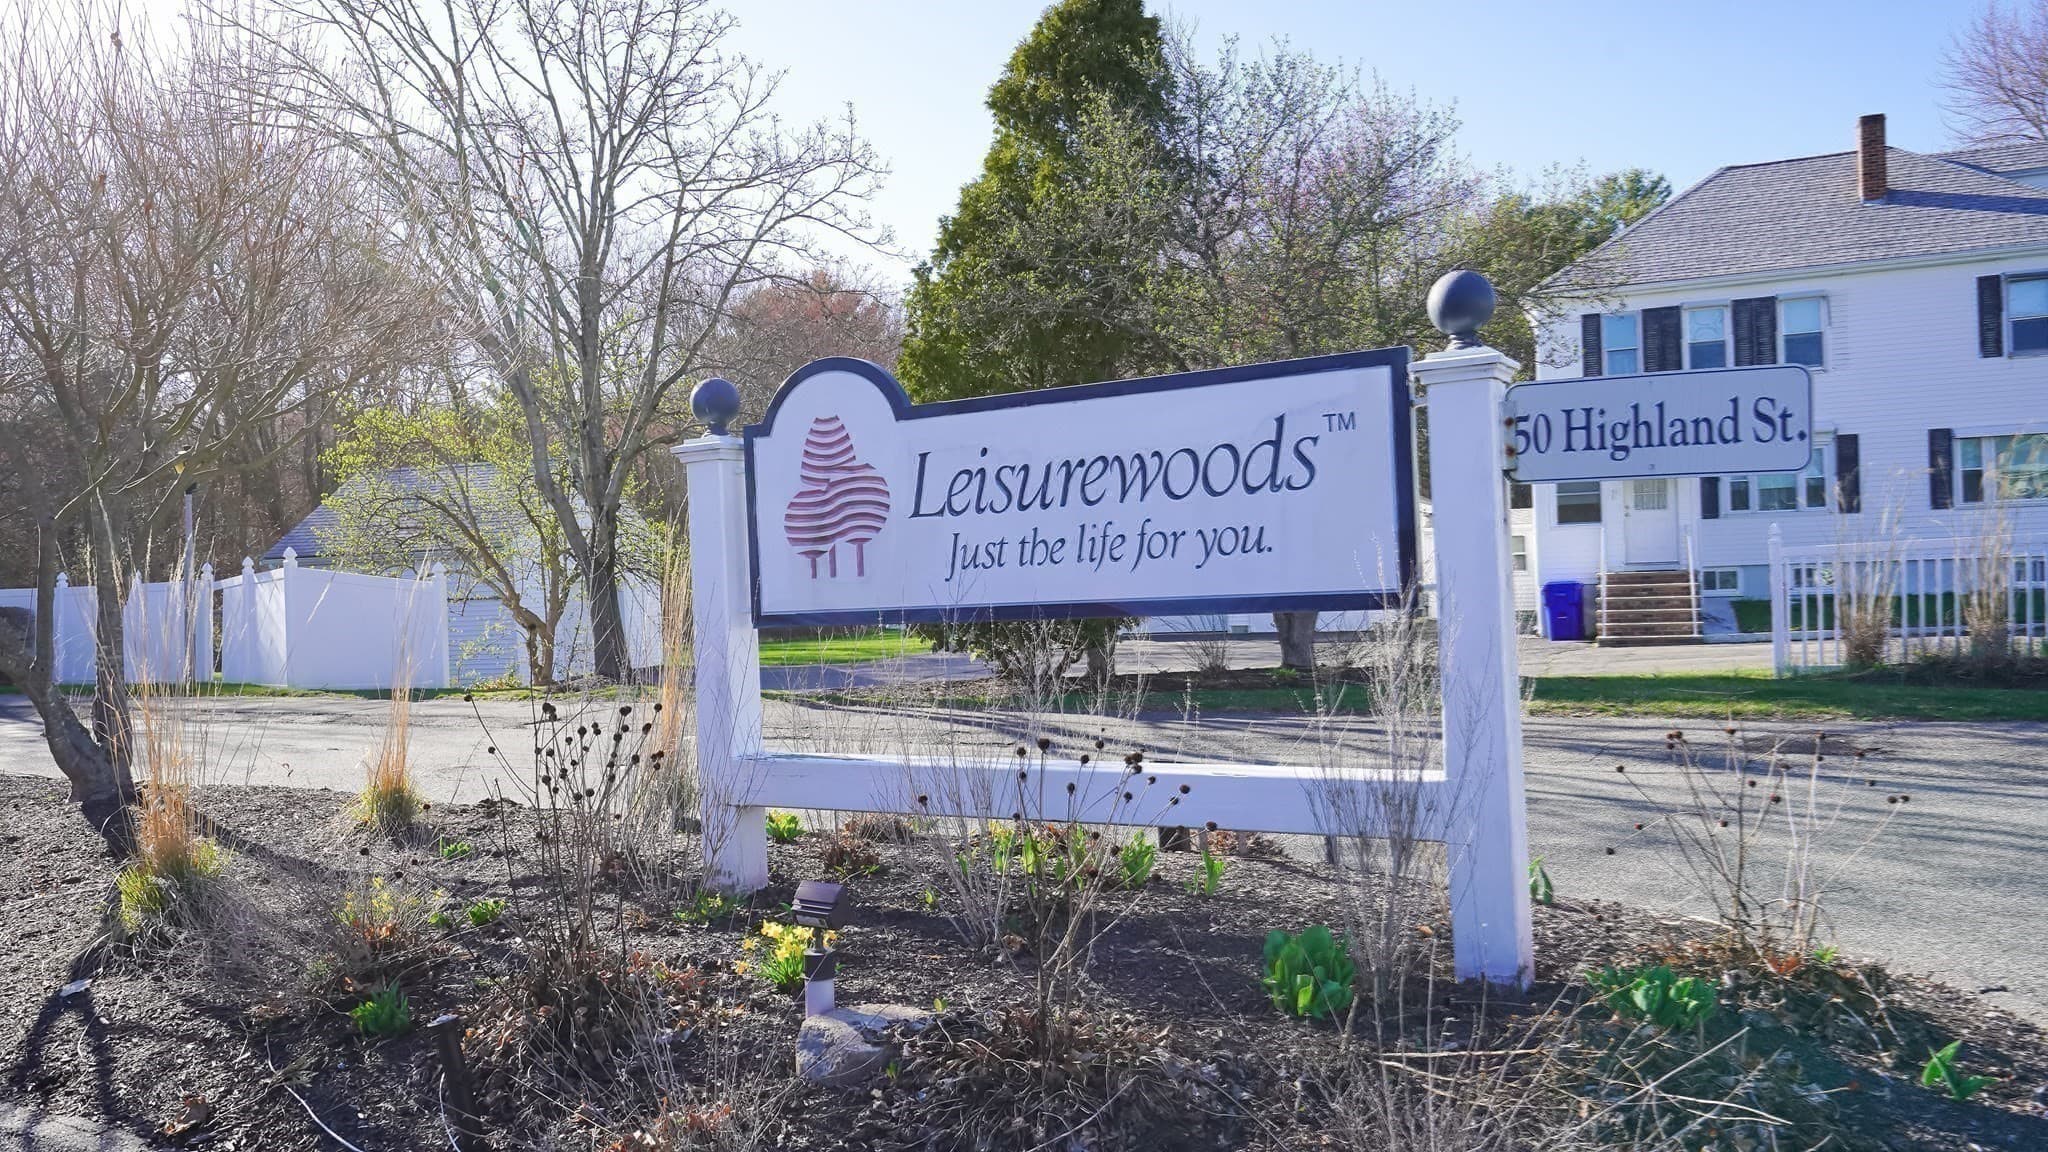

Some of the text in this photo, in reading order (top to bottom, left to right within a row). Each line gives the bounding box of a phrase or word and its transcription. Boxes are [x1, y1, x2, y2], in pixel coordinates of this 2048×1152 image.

[1515, 396, 1807, 461] 50 Highland St.
[909, 414, 1320, 519] Leisurewoods
[944, 519, 1274, 582] Just the life for you.
